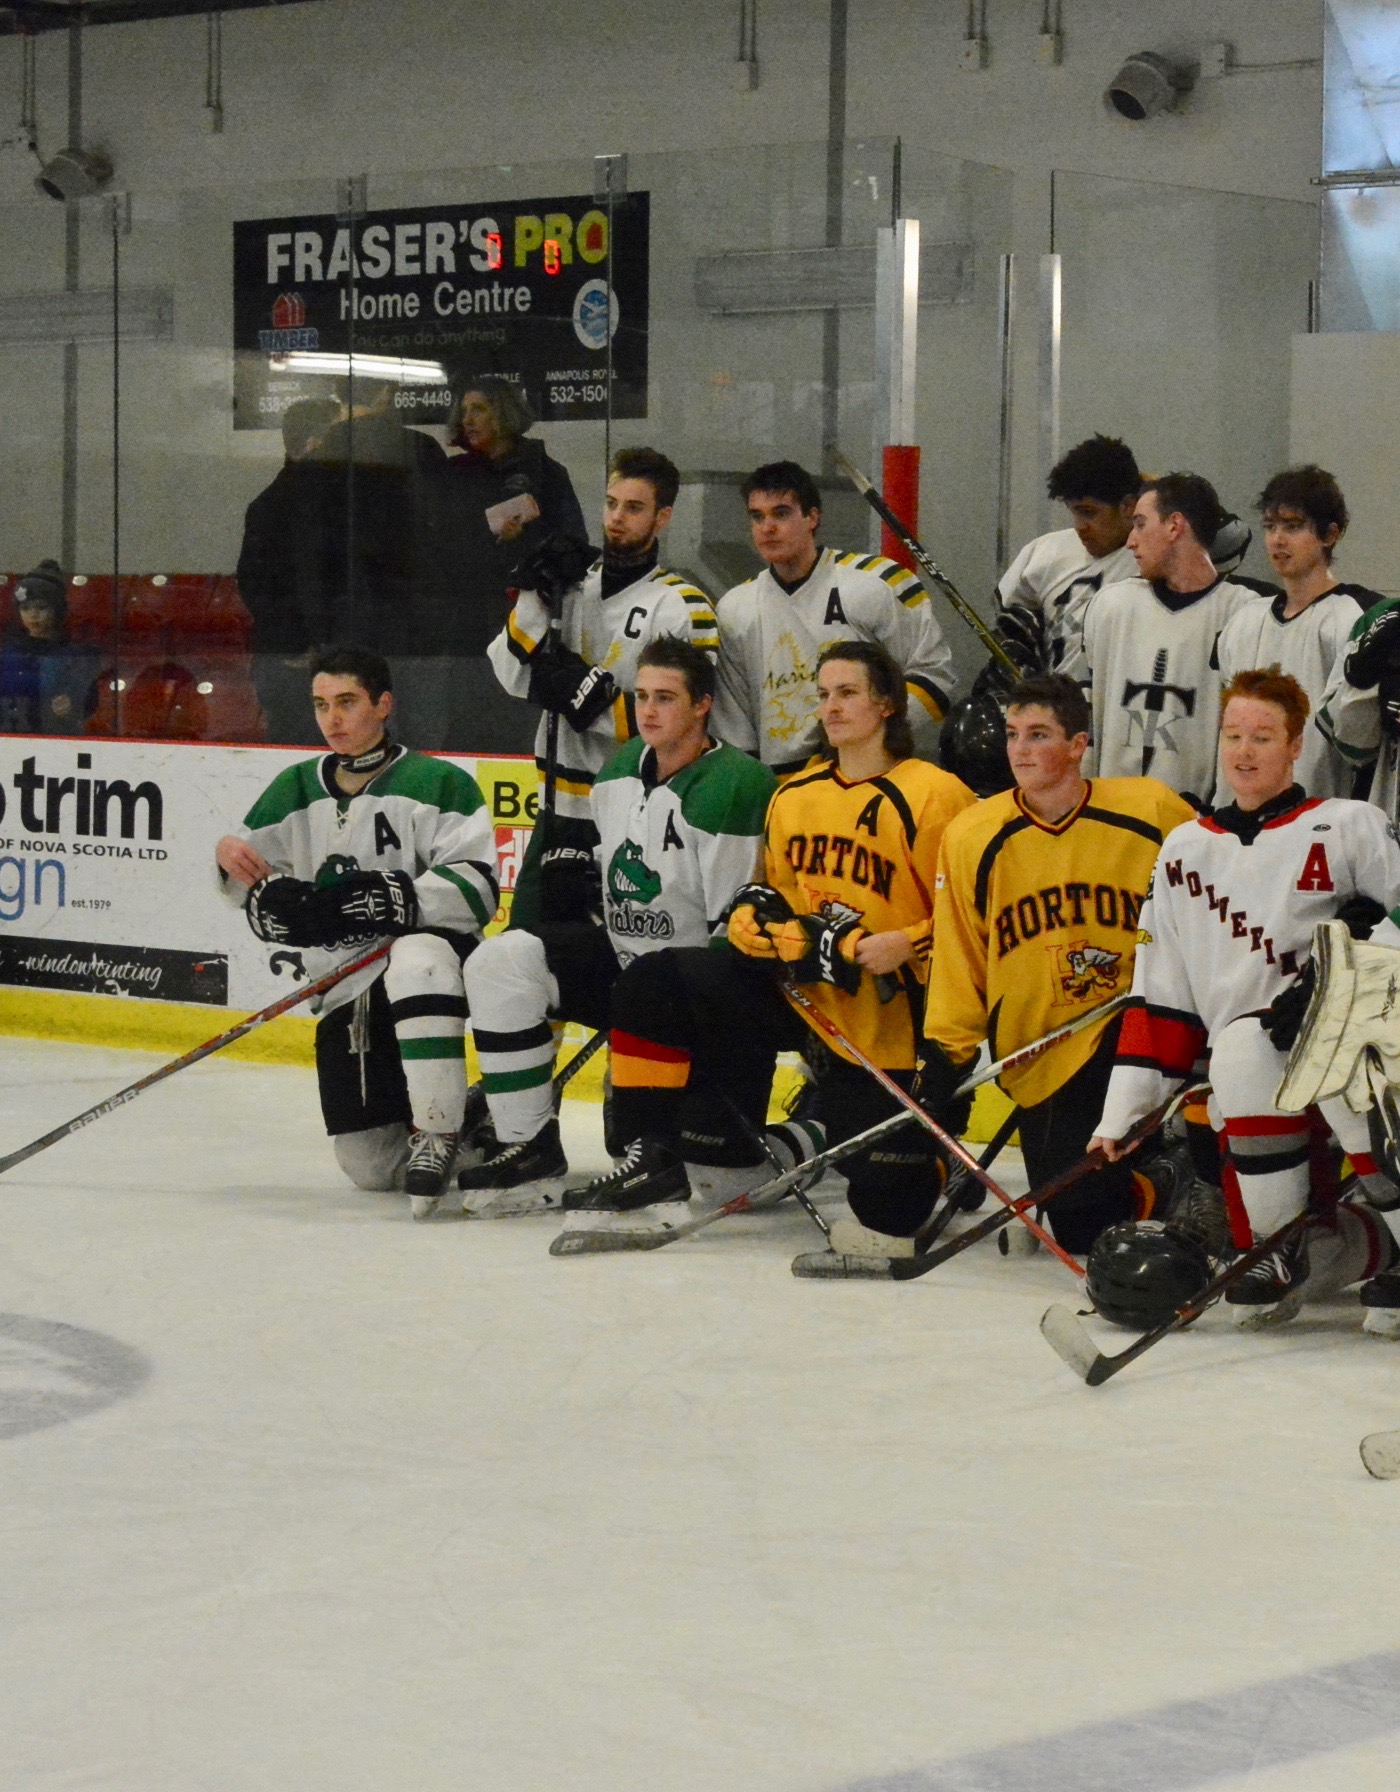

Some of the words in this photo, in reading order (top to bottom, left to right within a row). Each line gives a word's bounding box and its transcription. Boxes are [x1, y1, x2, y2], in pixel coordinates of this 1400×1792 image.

[267, 217, 501, 284] FRASER'S
[514, 210, 610, 268] PRO
[340, 287, 420, 321] Home
[434, 280, 532, 318] Centre
[394, 391, 452, 408] 665-4449
[623, 605, 649, 640] C
[823, 586, 849, 626] A
[14, 753, 163, 841] trim
[855, 793, 885, 838] A
[20, 839, 67, 854] NOVA
[72, 843, 133, 859] SCOTIA
[138, 848, 168, 861] LTD
[375, 810, 402, 856] A
[662, 808, 686, 852] A
[1297, 842, 1335, 892] A
[995, 882, 1139, 960] HORTON
[1165, 858, 1311, 978] WOLVERIN
[68, 1087, 142, 1135] BAUER
